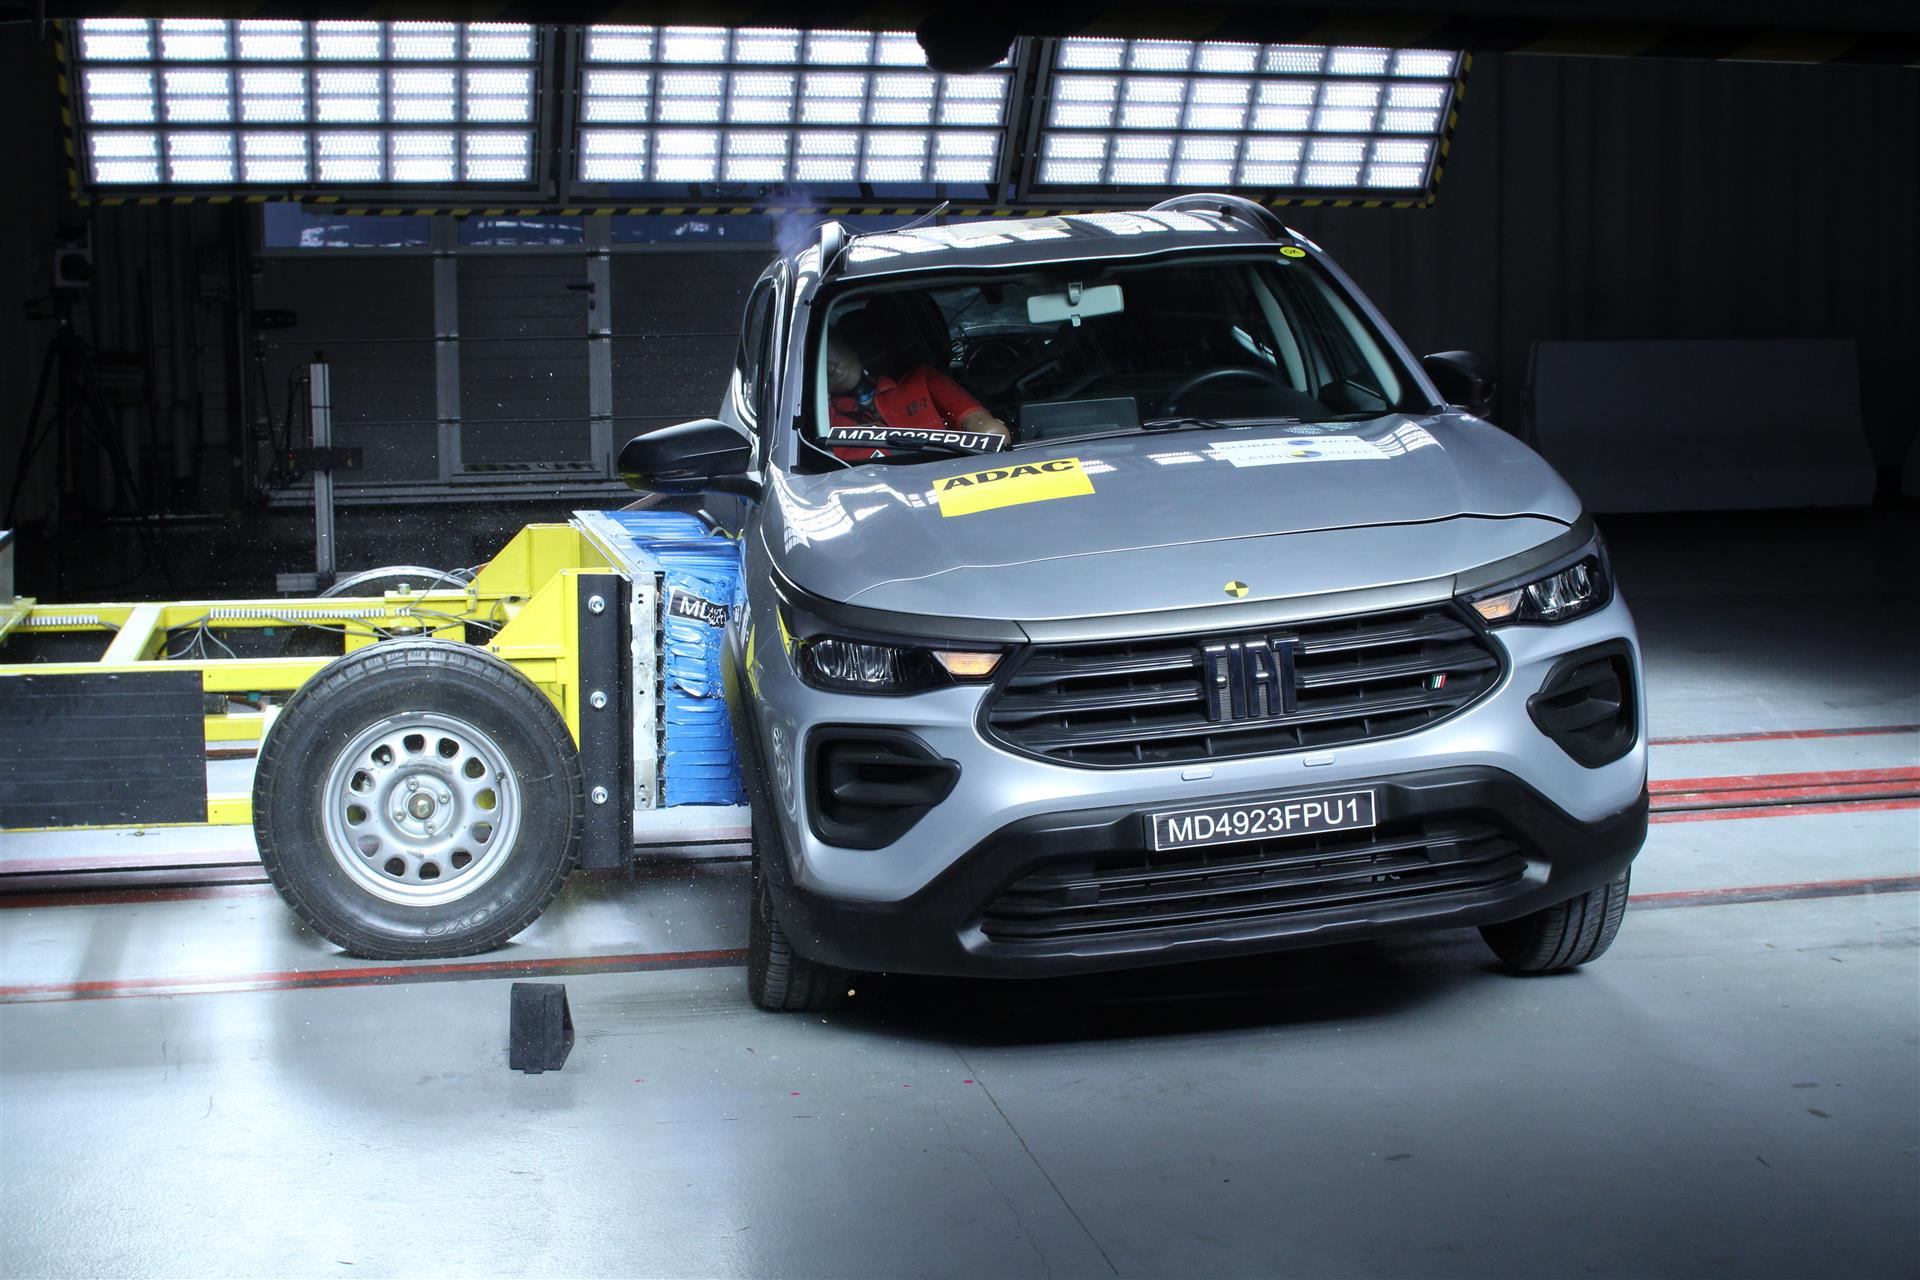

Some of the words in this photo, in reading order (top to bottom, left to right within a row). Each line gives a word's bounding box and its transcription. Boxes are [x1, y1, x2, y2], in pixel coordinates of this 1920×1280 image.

[943, 460, 1075, 491] ADAC
[1204, 637, 1299, 721] FIAT
[1168, 798, 1358, 843] MD4923FPU1
